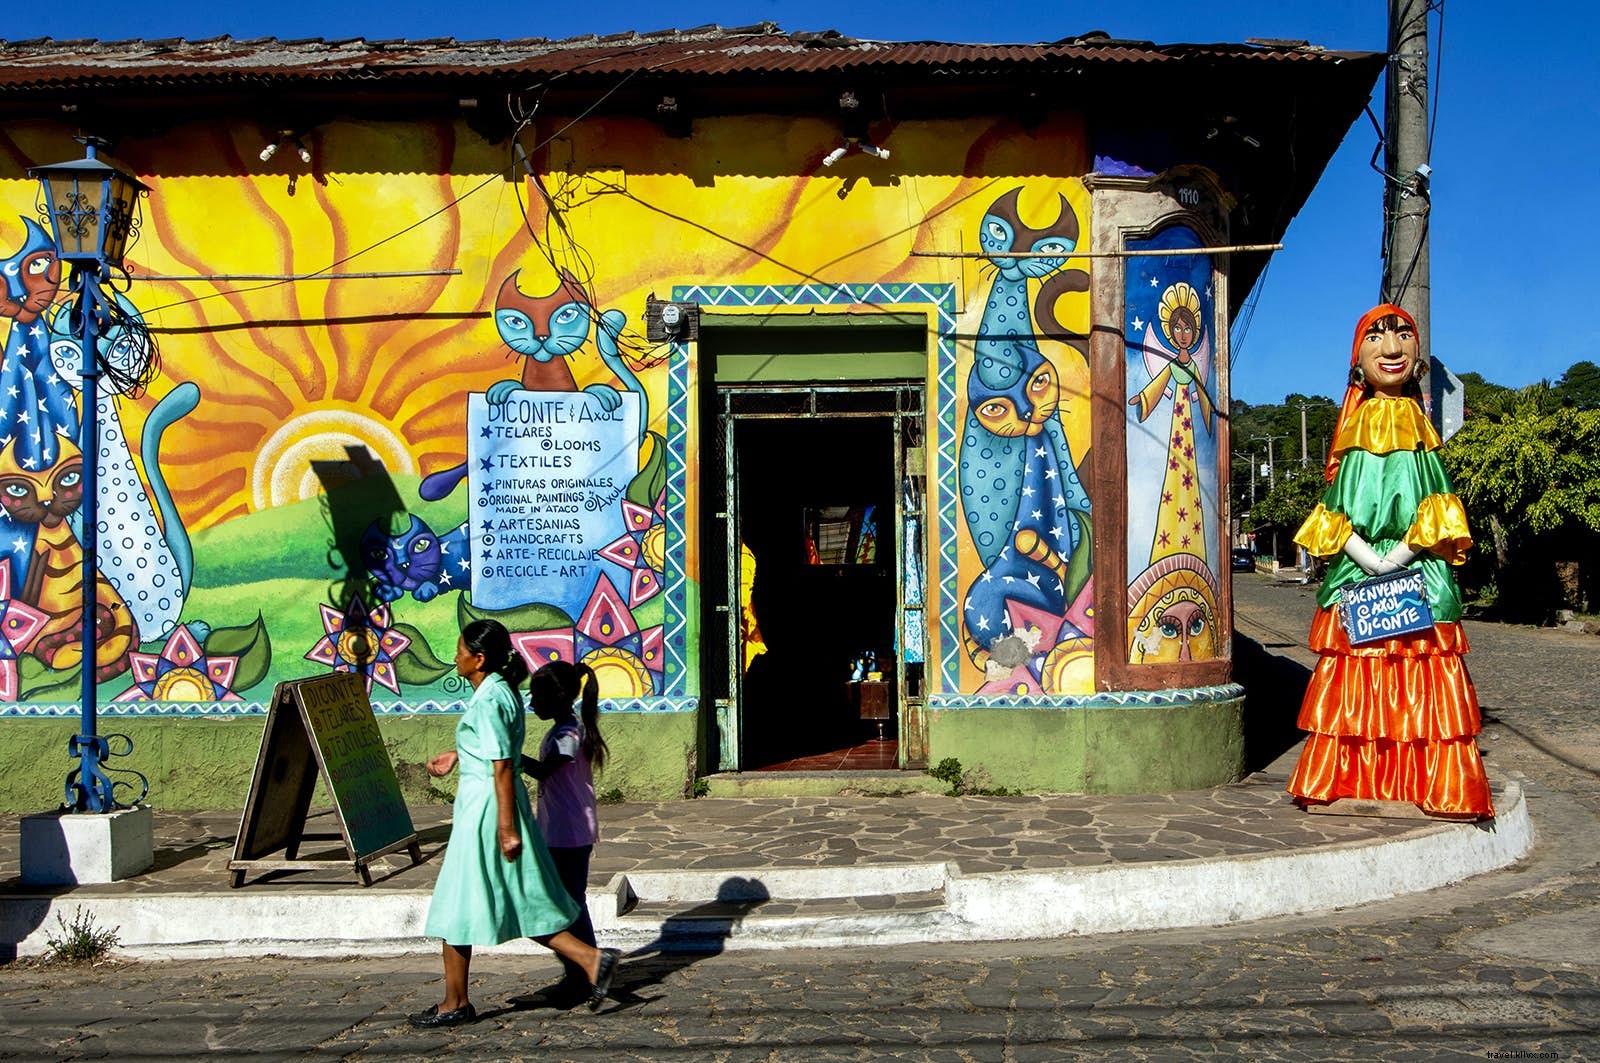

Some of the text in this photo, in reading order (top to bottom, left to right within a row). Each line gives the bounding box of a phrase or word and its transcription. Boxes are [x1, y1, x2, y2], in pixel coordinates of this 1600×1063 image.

[488, 399, 566, 424] DICONTE
[494, 426, 552, 438] TELARES
[555, 440, 600, 452] LOOMS
[499, 454, 572, 468] TEXTILES
[495, 477, 613, 491] PINTURAS ORIGINALES
[489, 491, 584, 505] ORIGINAL PAINTINGS
[495, 505, 579, 514] MADE IN ATACO
[499, 518, 580, 531] ARTESANIAS
[500, 533, 583, 545] HANDCRAFTS
[1357, 607, 1420, 636] DICONTE
[307, 676, 360, 708] DICONTE
